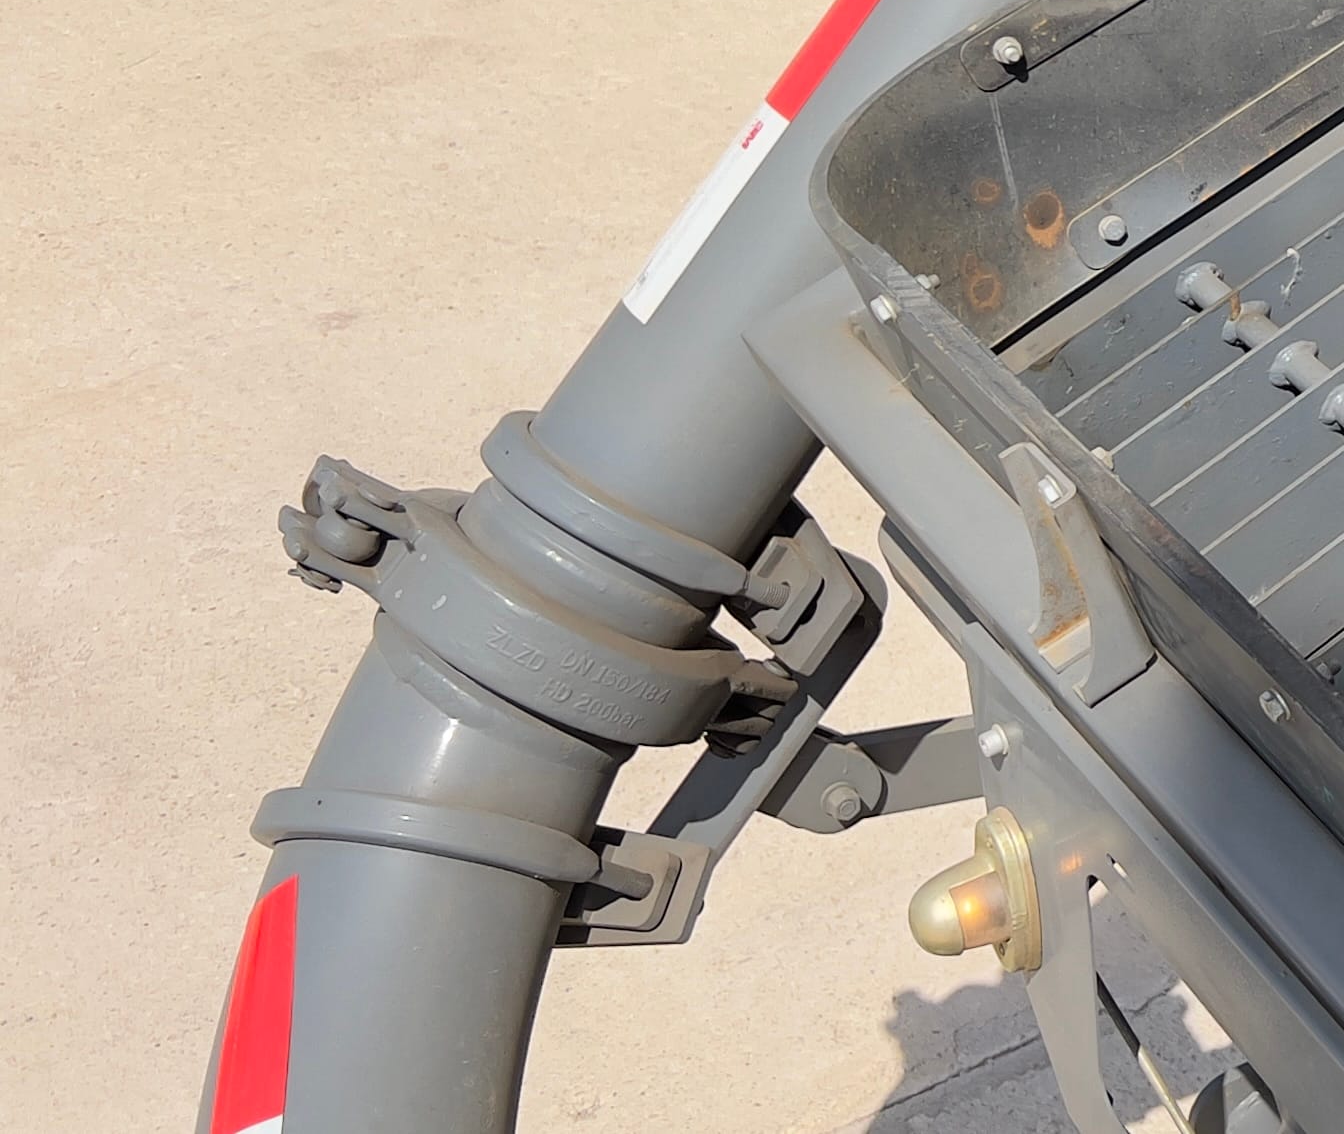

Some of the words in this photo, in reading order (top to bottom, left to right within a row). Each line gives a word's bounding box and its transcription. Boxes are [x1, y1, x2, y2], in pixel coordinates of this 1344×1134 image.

[486, 624, 546, 673] ZLZD
[539, 676, 574, 703] HD
[559, 648, 596, 678] DN
[591, 665, 673, 706] 150/184
